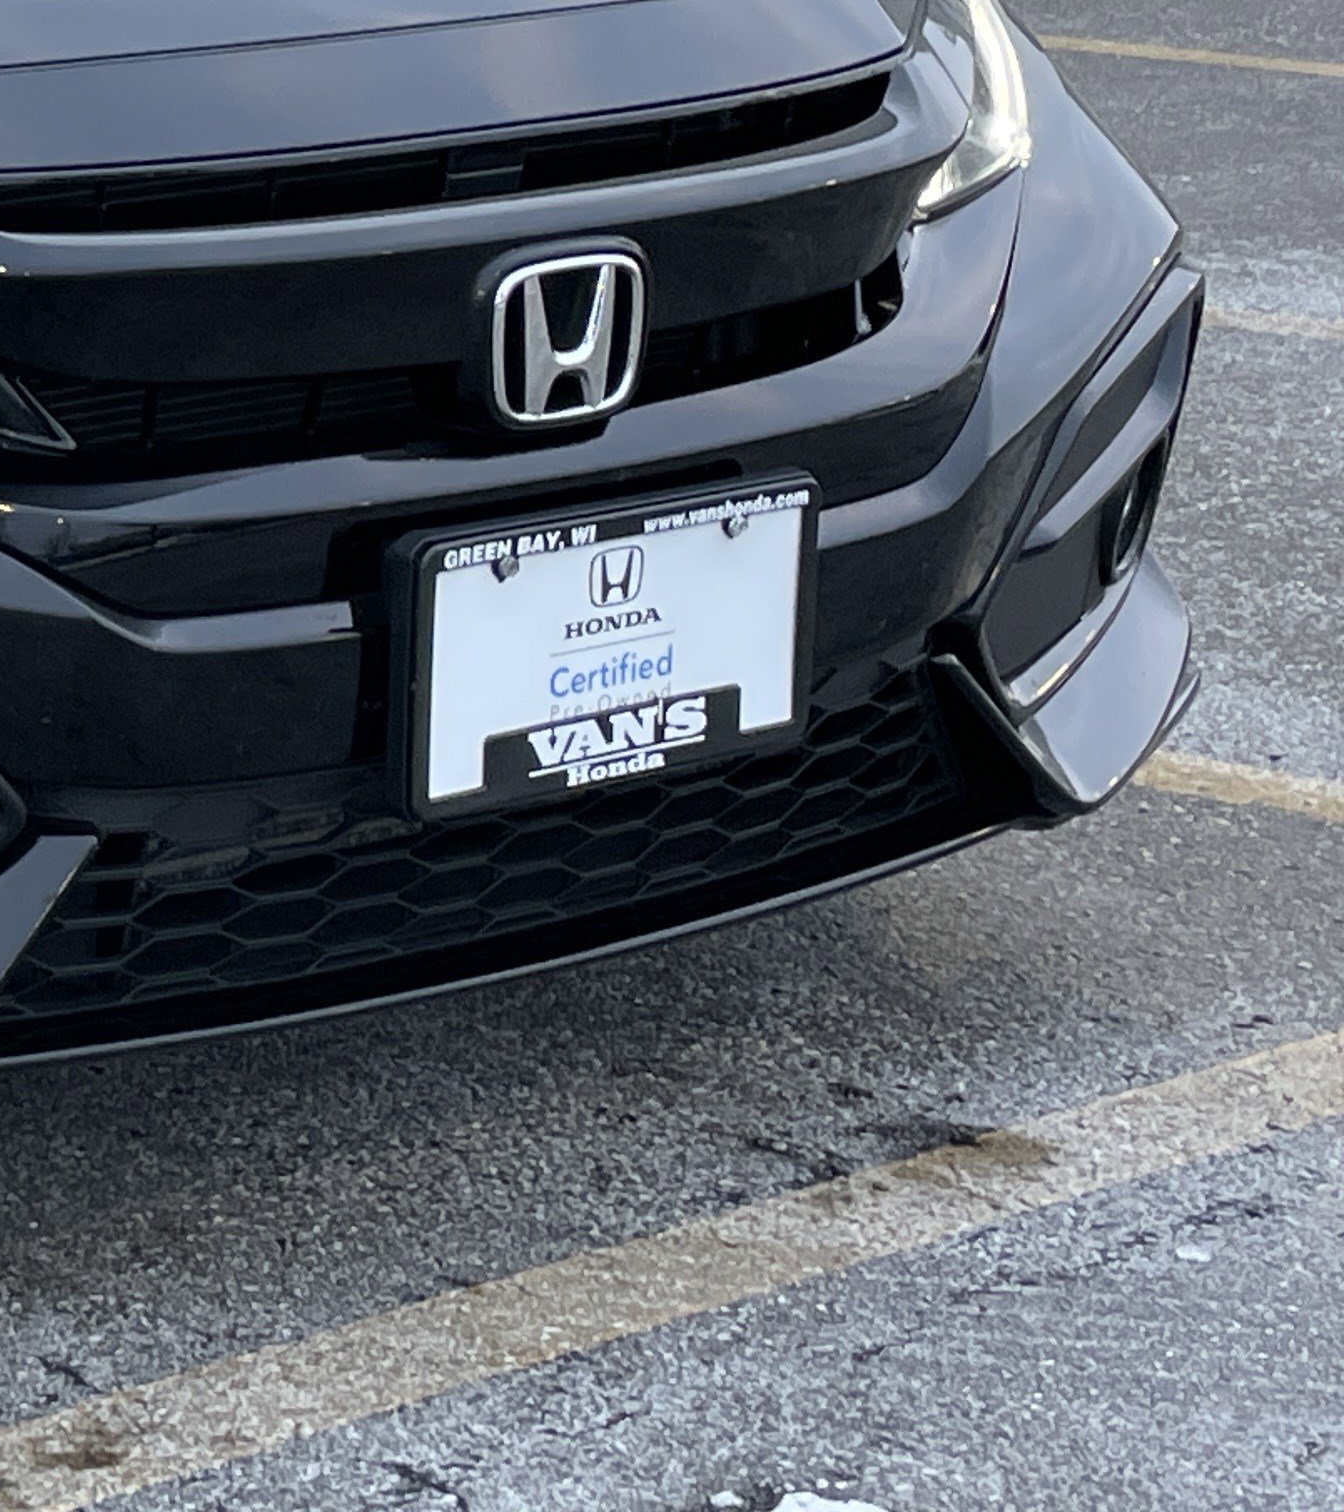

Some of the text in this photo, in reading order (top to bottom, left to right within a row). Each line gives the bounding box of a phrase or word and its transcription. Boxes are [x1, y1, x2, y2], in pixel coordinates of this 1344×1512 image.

[644, 489, 810, 534] www.vanshonda.com
[444, 524, 597, 570] GREEN BAY, WI
[564, 607, 662, 640] HONDA
[549, 643, 674, 698] Certified
[527, 696, 708, 767] VAN'S
[566, 750, 666, 788] Honda
